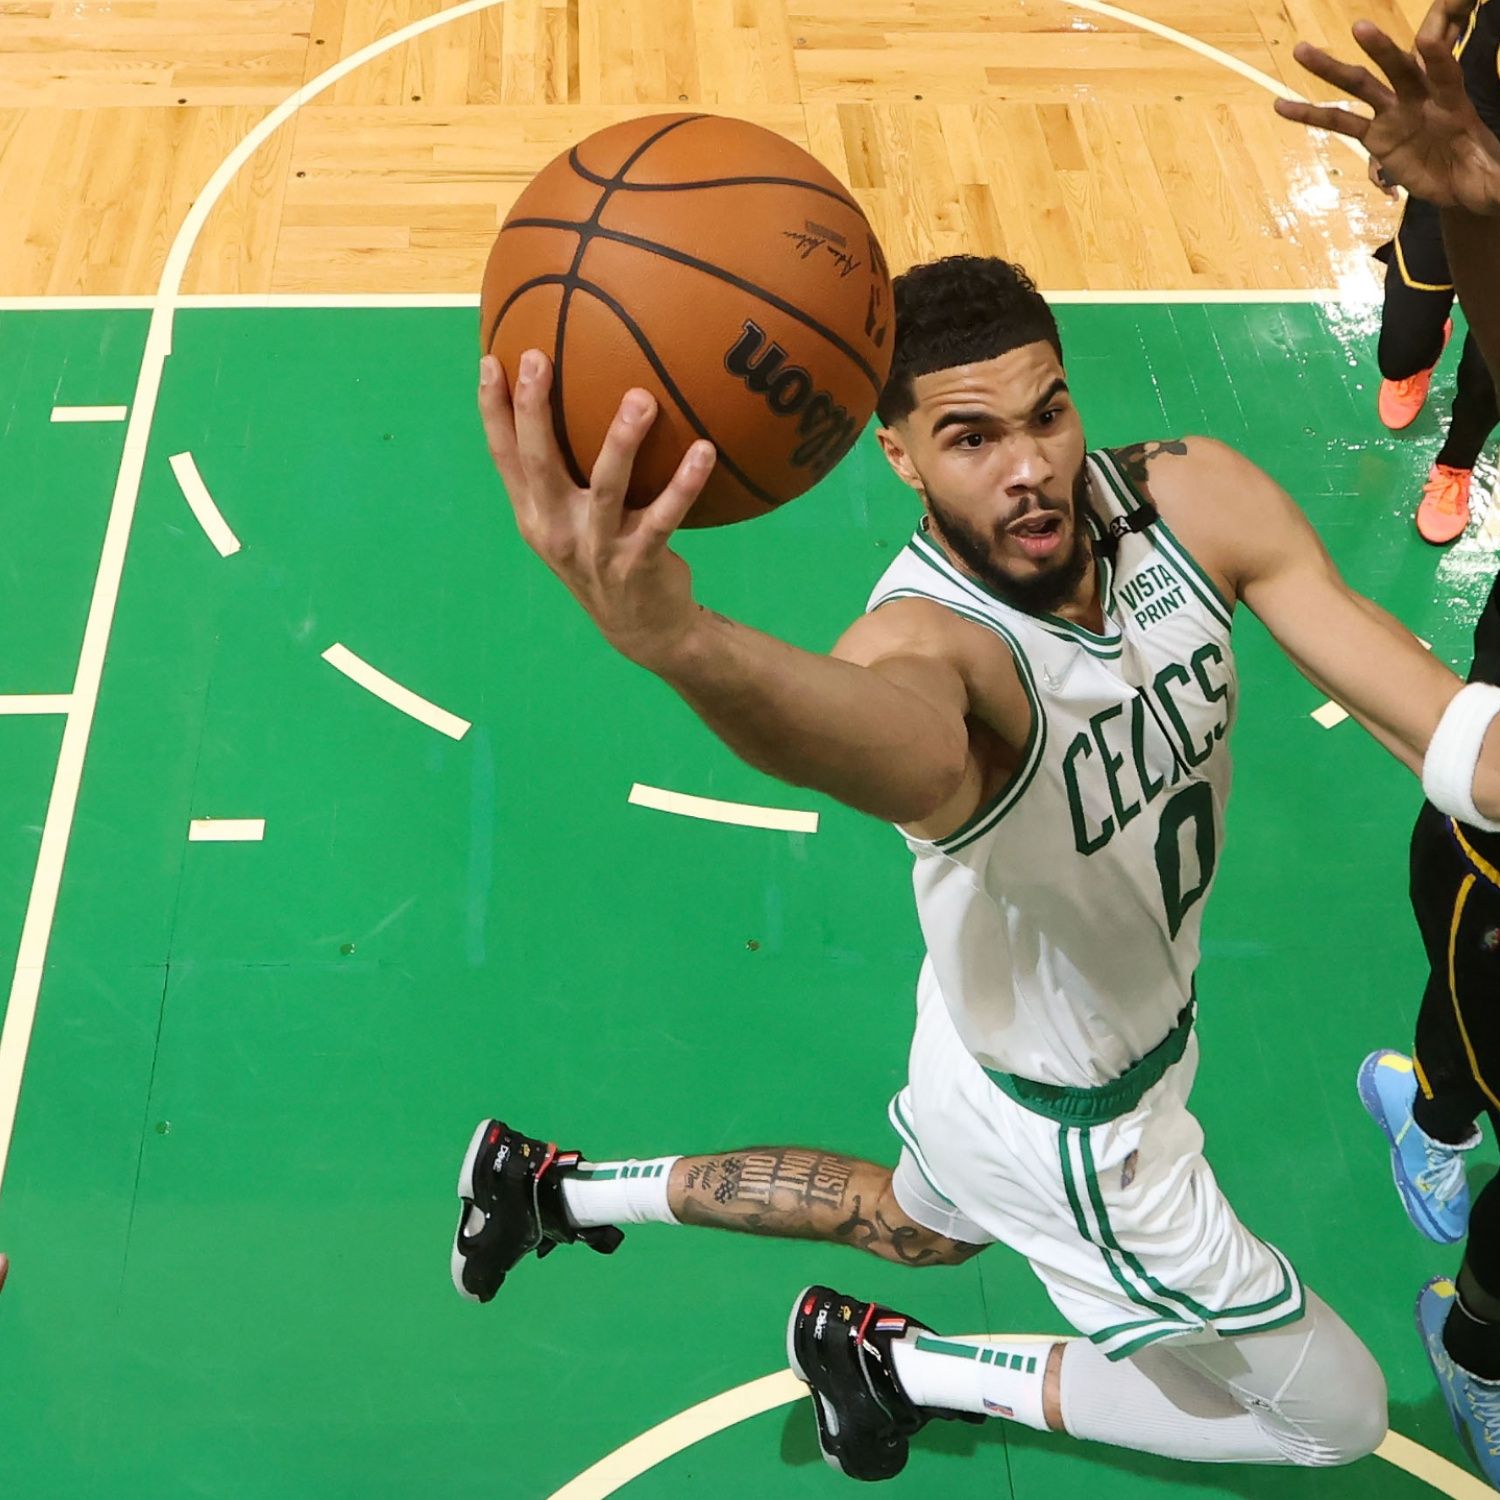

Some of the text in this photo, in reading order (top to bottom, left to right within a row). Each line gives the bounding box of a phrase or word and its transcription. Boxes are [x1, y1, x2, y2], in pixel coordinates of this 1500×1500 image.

[1118, 564, 1178, 611] VISTA
[1134, 585, 1187, 631] PRINT
[1063, 642, 1229, 857] CELICS
[1154, 780, 1216, 942] 0
[810, 1154, 852, 1208] JUST
